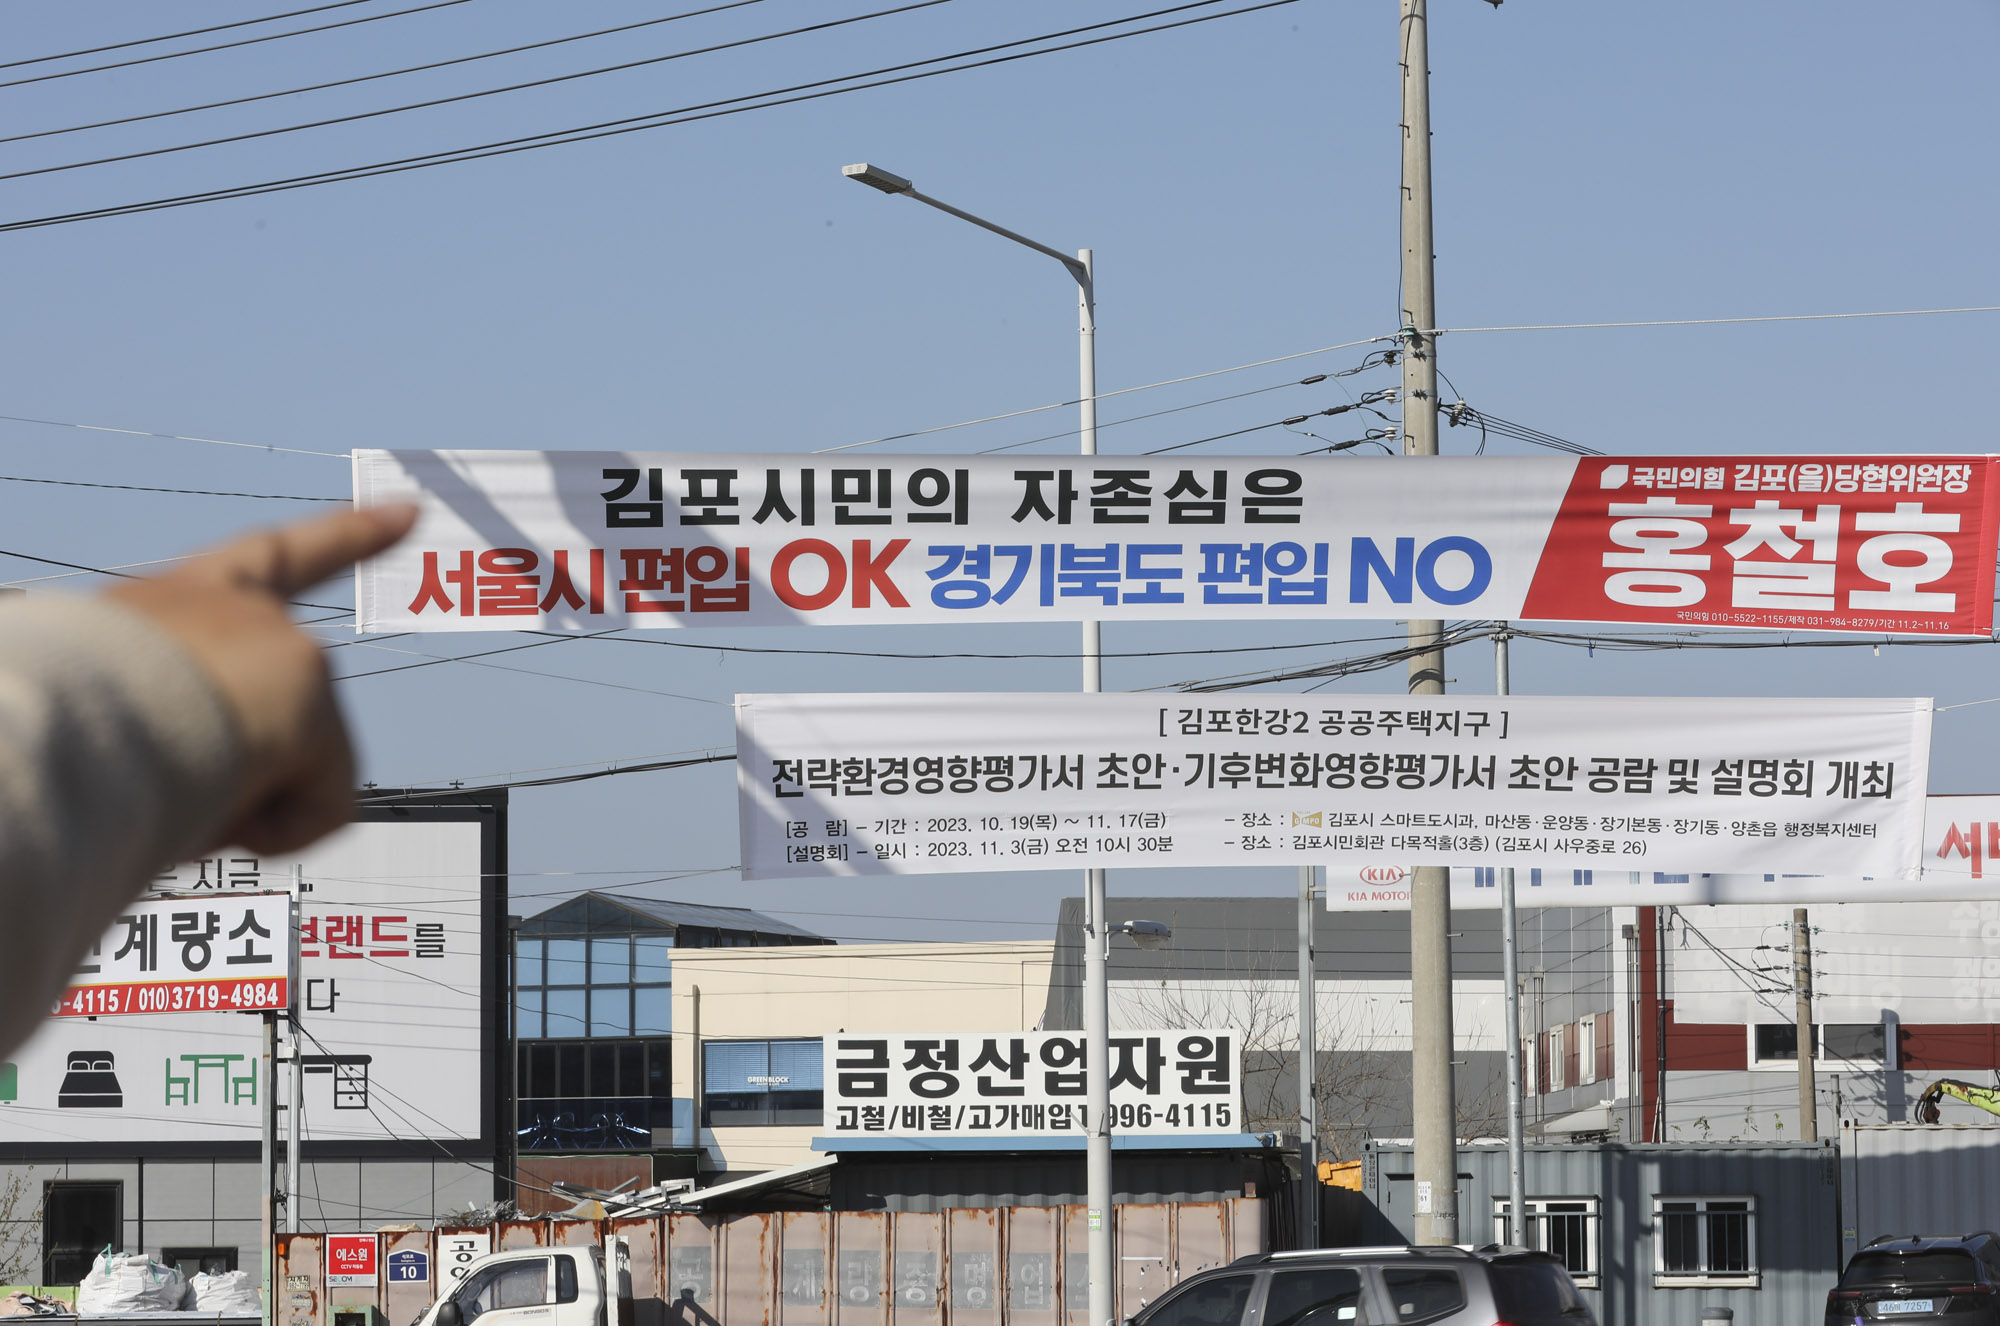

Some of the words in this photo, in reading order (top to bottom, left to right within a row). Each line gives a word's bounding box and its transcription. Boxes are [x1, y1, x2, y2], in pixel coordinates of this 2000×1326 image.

[1632, 465, 1726, 490] 국민의힘
[1734, 463, 1972, 494] 김포(을)당협위원장
[600, 467, 969, 528] 김포시민의
[1011, 468, 1303, 525] 자존심은
[1602, 497, 1961, 612] 홍철호
[408, 549, 604, 617] 서울시
[619, 546, 751, 613] 편입
[770, 538, 912, 611] OK
[925, 543, 1185, 609] 경기북도
[1198, 541, 1329, 605] 편입
[1349, 535, 1492, 606] NO
[1676, 611, 1709, 621] 국민의힘
[772, 754, 1084, 798] 전략환경영향평가서
[1507, 755, 1580, 792] 초안
[1587, 757, 1659, 794] 공람
[1668, 759, 1700, 795] 및
[1711, 758, 1814, 798] 설명회
[1826, 760, 1894, 800] 개최
[875, 818, 907, 835] 기간
[927, 818, 972, 832] 2023.
[980, 816, 1004, 831] 10.
[1011, 813, 1058, 832] 19(목)
[1087, 814, 1111, 829] 11.
[1119, 812, 1167, 829] 17(금)
[1242, 812, 1272, 828] 장소
[1328, 812, 1374, 828] 김포시
[1784, 822, 1877, 839] 행정복지센터
[787, 844, 848, 863] [설명회]
[875, 842, 906, 860] 일시
[928, 842, 972, 857] 2023.
[981, 841, 1004, 856] 11.
[1011, 838, 1049, 855] 3(금)
[1056, 837, 1088, 854] 오전
[1096, 836, 1130, 853] 10시
[1137, 836, 1174, 852] 30분
[1241, 835, 1272, 850] 장소
[1292, 835, 1386, 851] 김포시민회관
[1391, 835, 1490, 852] 다목적홀(3층)
[1496, 836, 1548, 853] (김포시
[1554, 838, 1617, 855] 사우중로
[1623, 840, 1648, 857] 26)
[1367, 868, 1397, 881] KIA
[1347, 892, 1367, 901] KIA
[836, 1035, 1230, 1099] 금정산업자원
[336, 1248, 368, 1261] 에스원
[329, 1275, 353, 1283] SECOM
[400, 1266, 417, 1279] 10
[1904, 1301, 1928, 1311] 7257
